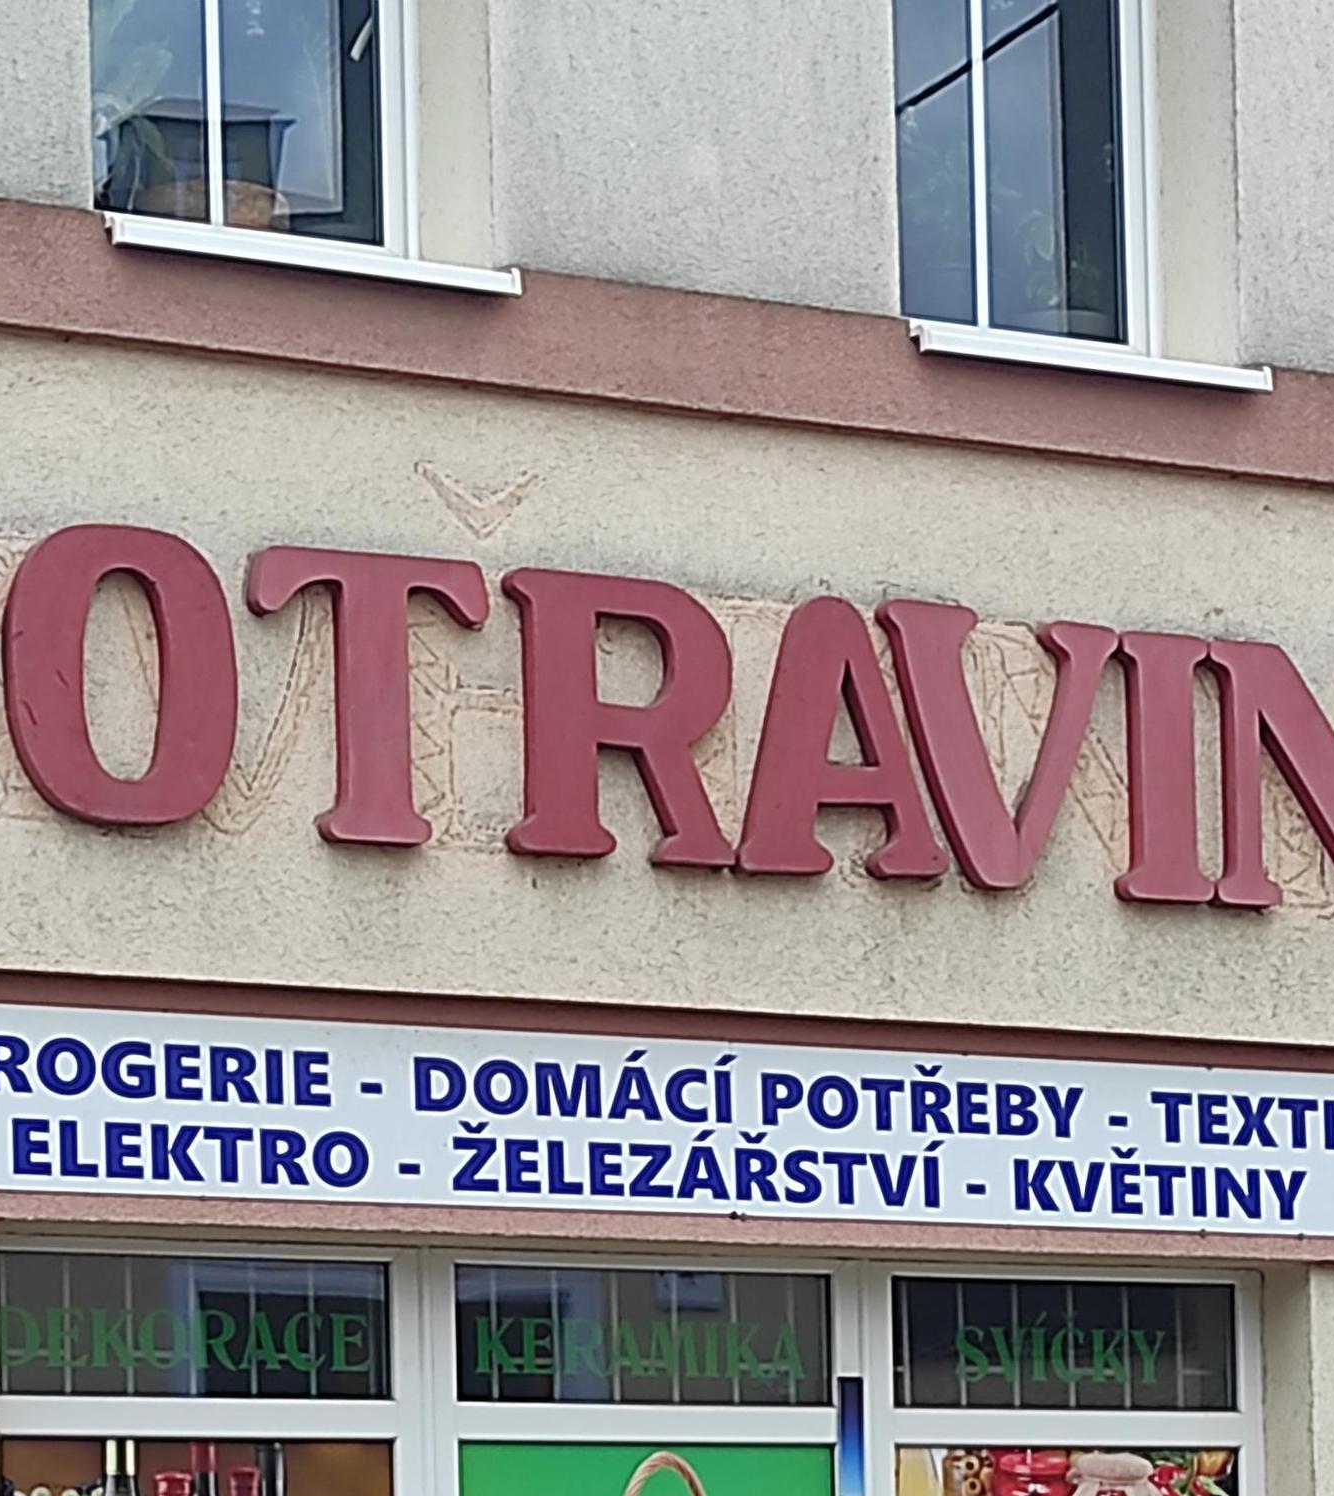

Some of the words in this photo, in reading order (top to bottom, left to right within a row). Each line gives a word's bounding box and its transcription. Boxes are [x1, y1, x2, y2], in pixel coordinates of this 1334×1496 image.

[413, 1049, 737, 1125] DOMÁCÍ
[761, 1065, 1084, 1138] POTŘEBY
[10, 1116, 371, 1188] ELEKTRO
[452, 1121, 945, 1209] ŽELEZÁŘSTVÍ
[1015, 1146, 1308, 1221] KVĚTINY
[0, 1304, 372, 1373] DEKORACE
[474, 1316, 806, 1379] KERAMIKA
[955, 1311, 1166, 1384] SVÍČKY
